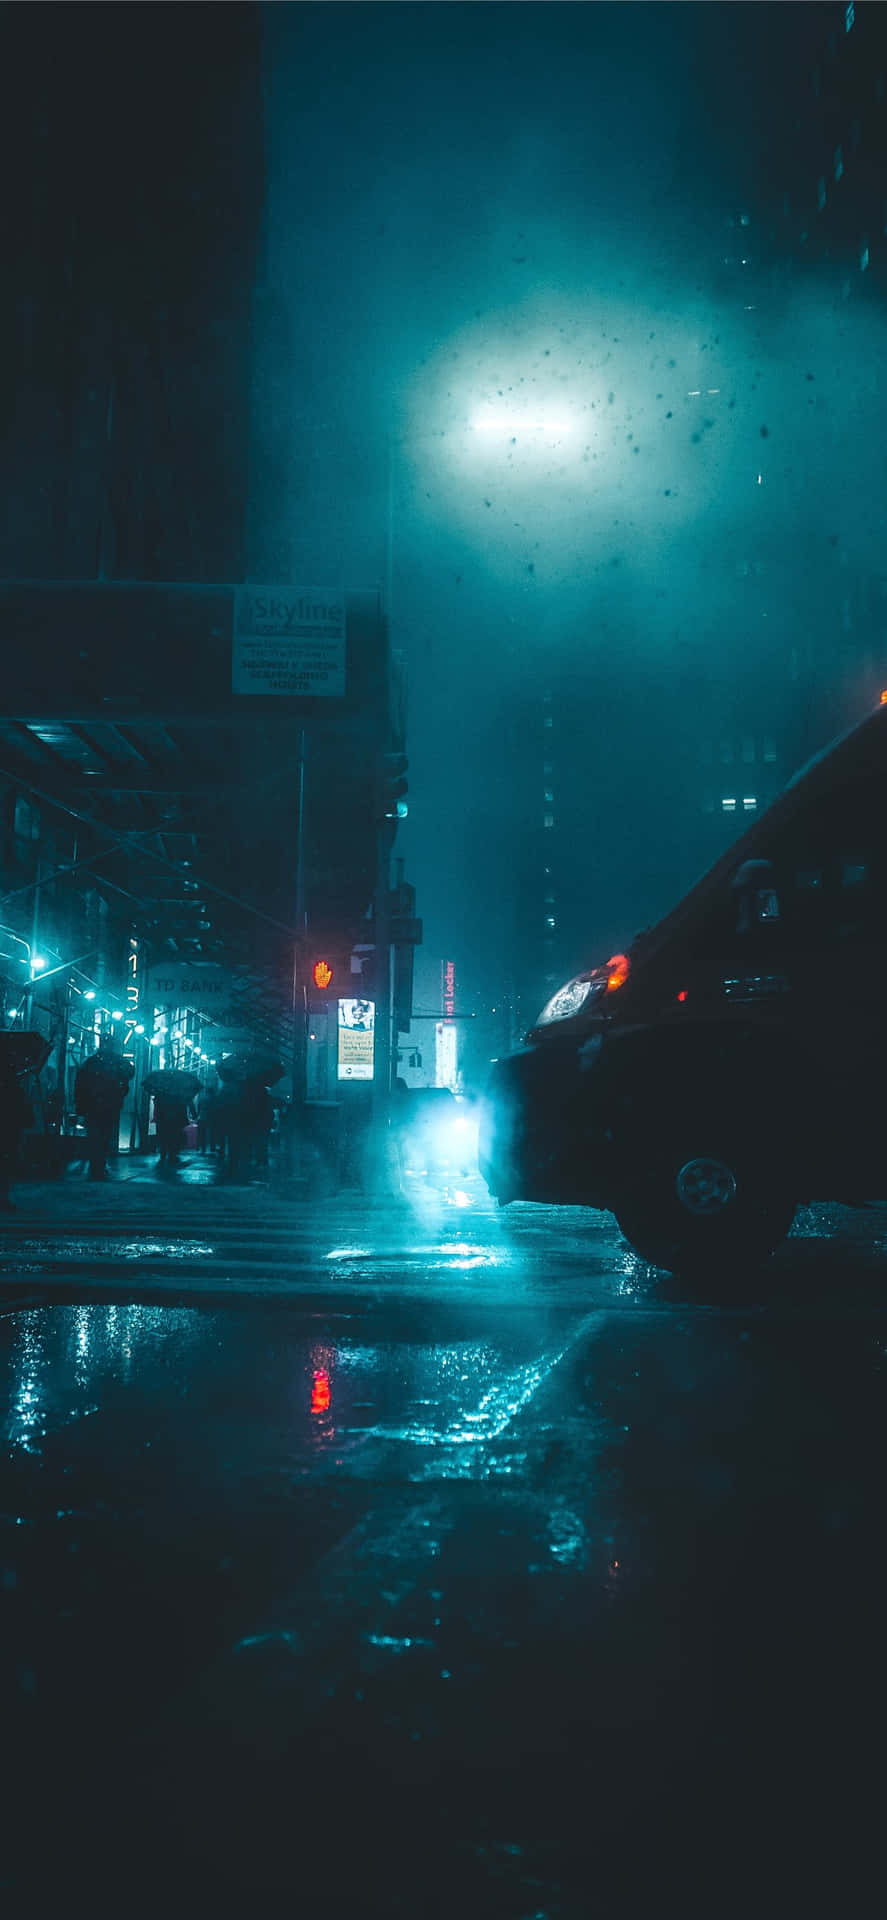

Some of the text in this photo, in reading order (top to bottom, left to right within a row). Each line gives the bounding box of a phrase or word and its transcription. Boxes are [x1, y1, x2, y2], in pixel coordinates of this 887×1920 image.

[254, 597, 343, 627] Skyline
[153, 978, 224, 992] TD BANK
[444, 961, 454, 997] Locker
